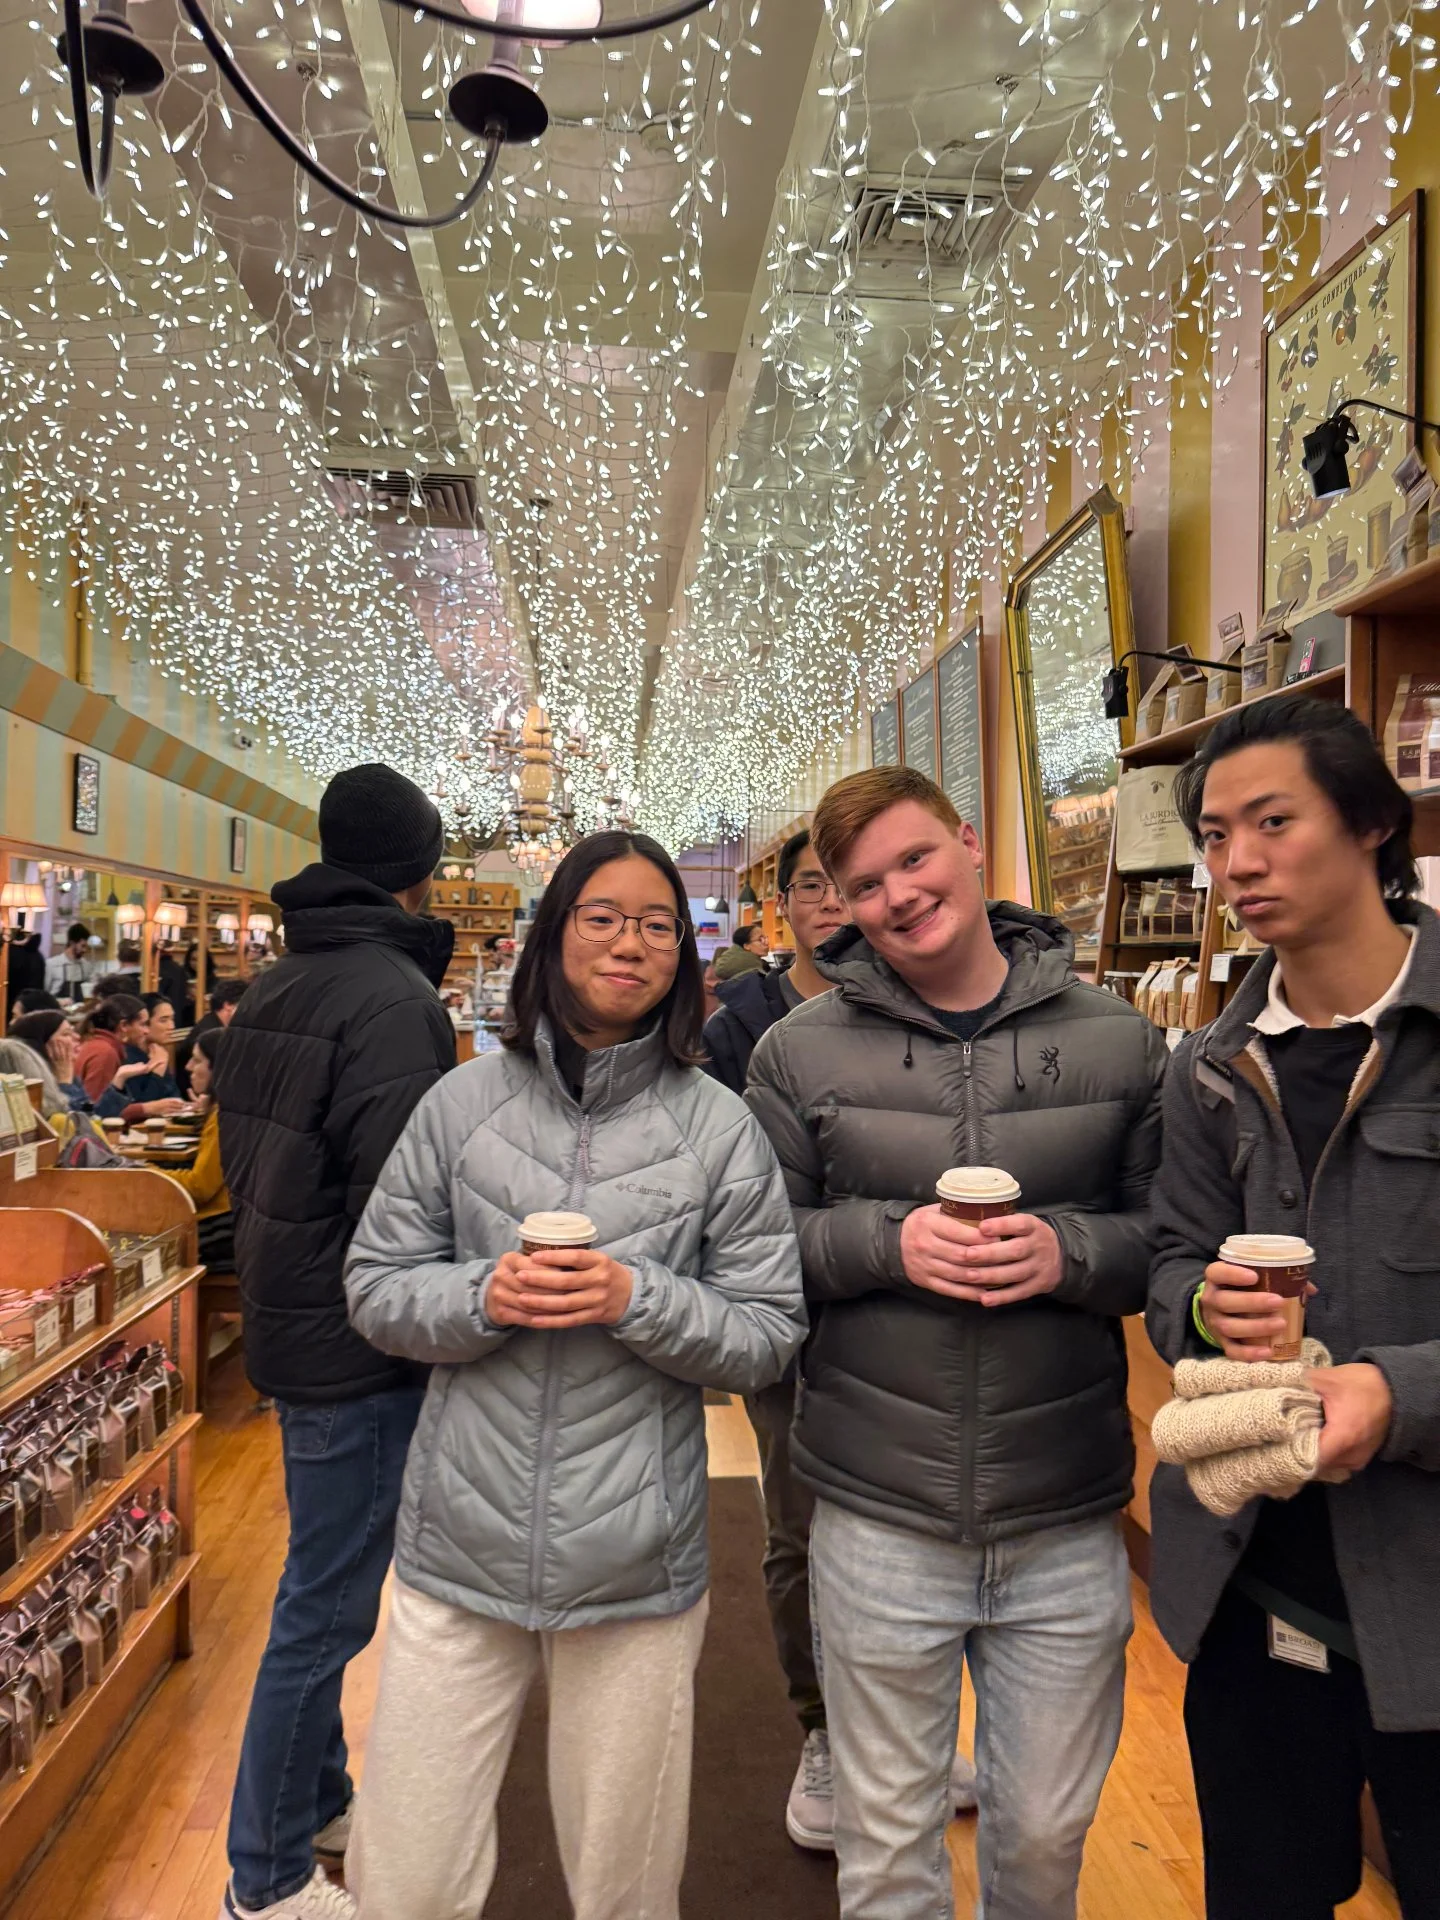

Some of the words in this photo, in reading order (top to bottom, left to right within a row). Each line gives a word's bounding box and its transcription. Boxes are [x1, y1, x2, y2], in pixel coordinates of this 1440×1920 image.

[1306, 304, 1319, 323] LES
[1150, 809, 1180, 820] BURDIC
[626, 1183, 672, 1199] Columbia
